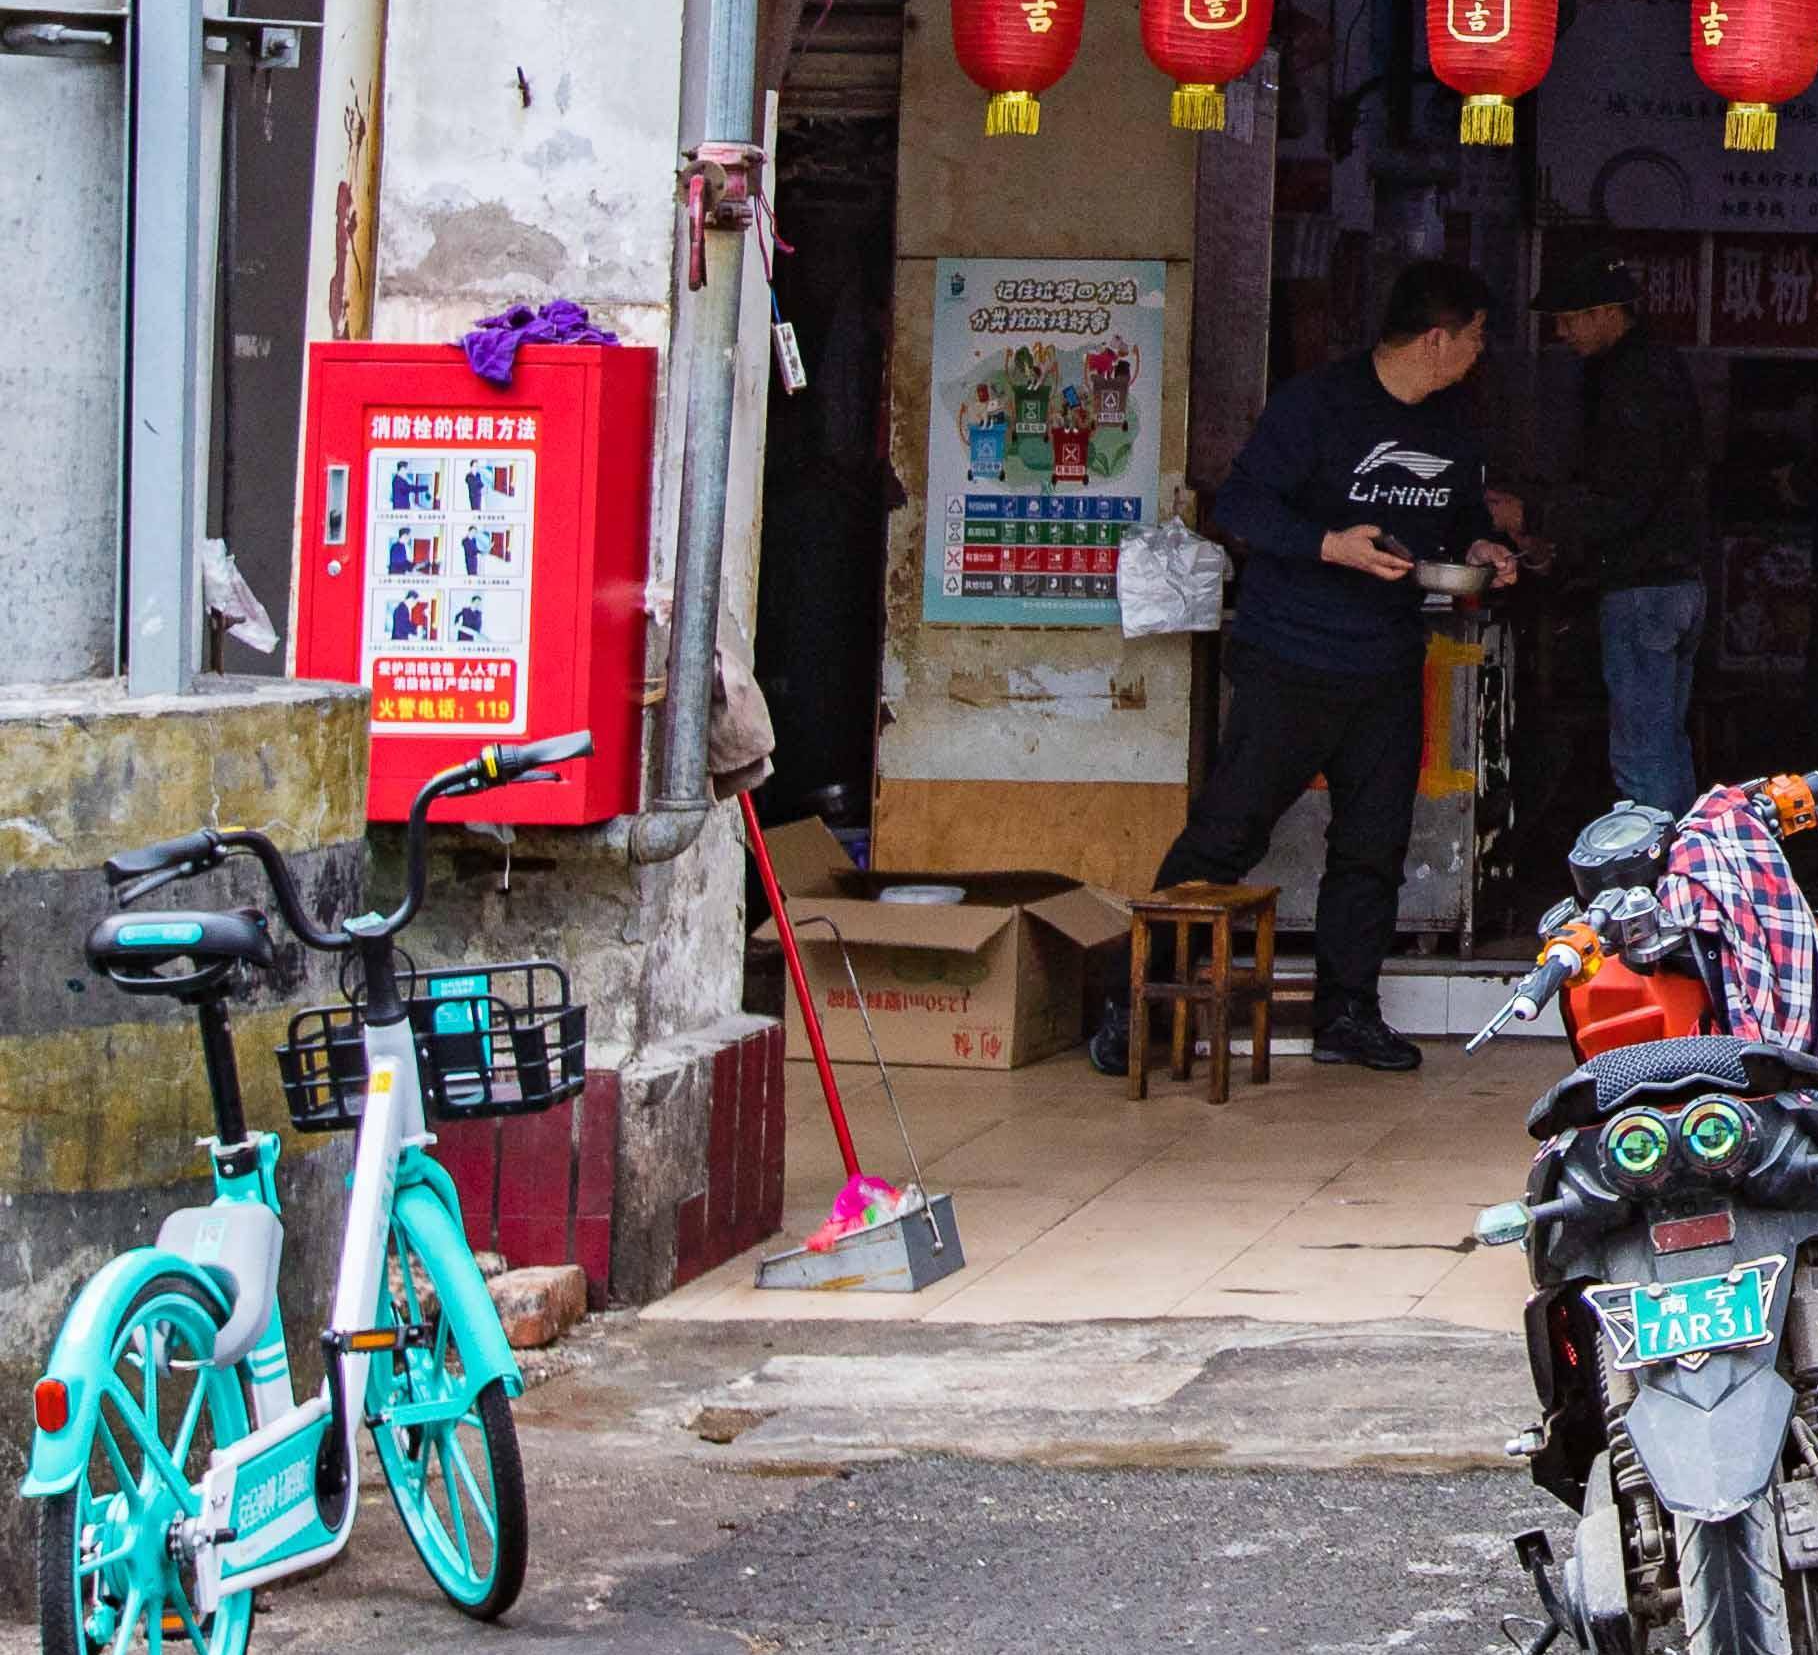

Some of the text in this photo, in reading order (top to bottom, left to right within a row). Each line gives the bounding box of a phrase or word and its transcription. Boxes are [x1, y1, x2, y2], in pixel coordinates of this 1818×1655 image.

[371, 414, 537, 441] 消防栓的使用方法
[1348, 481, 1453, 507] LI-NING
[1658, 1285, 1736, 1317] 南宁
[1641, 1306, 1754, 1352] 7AR31
